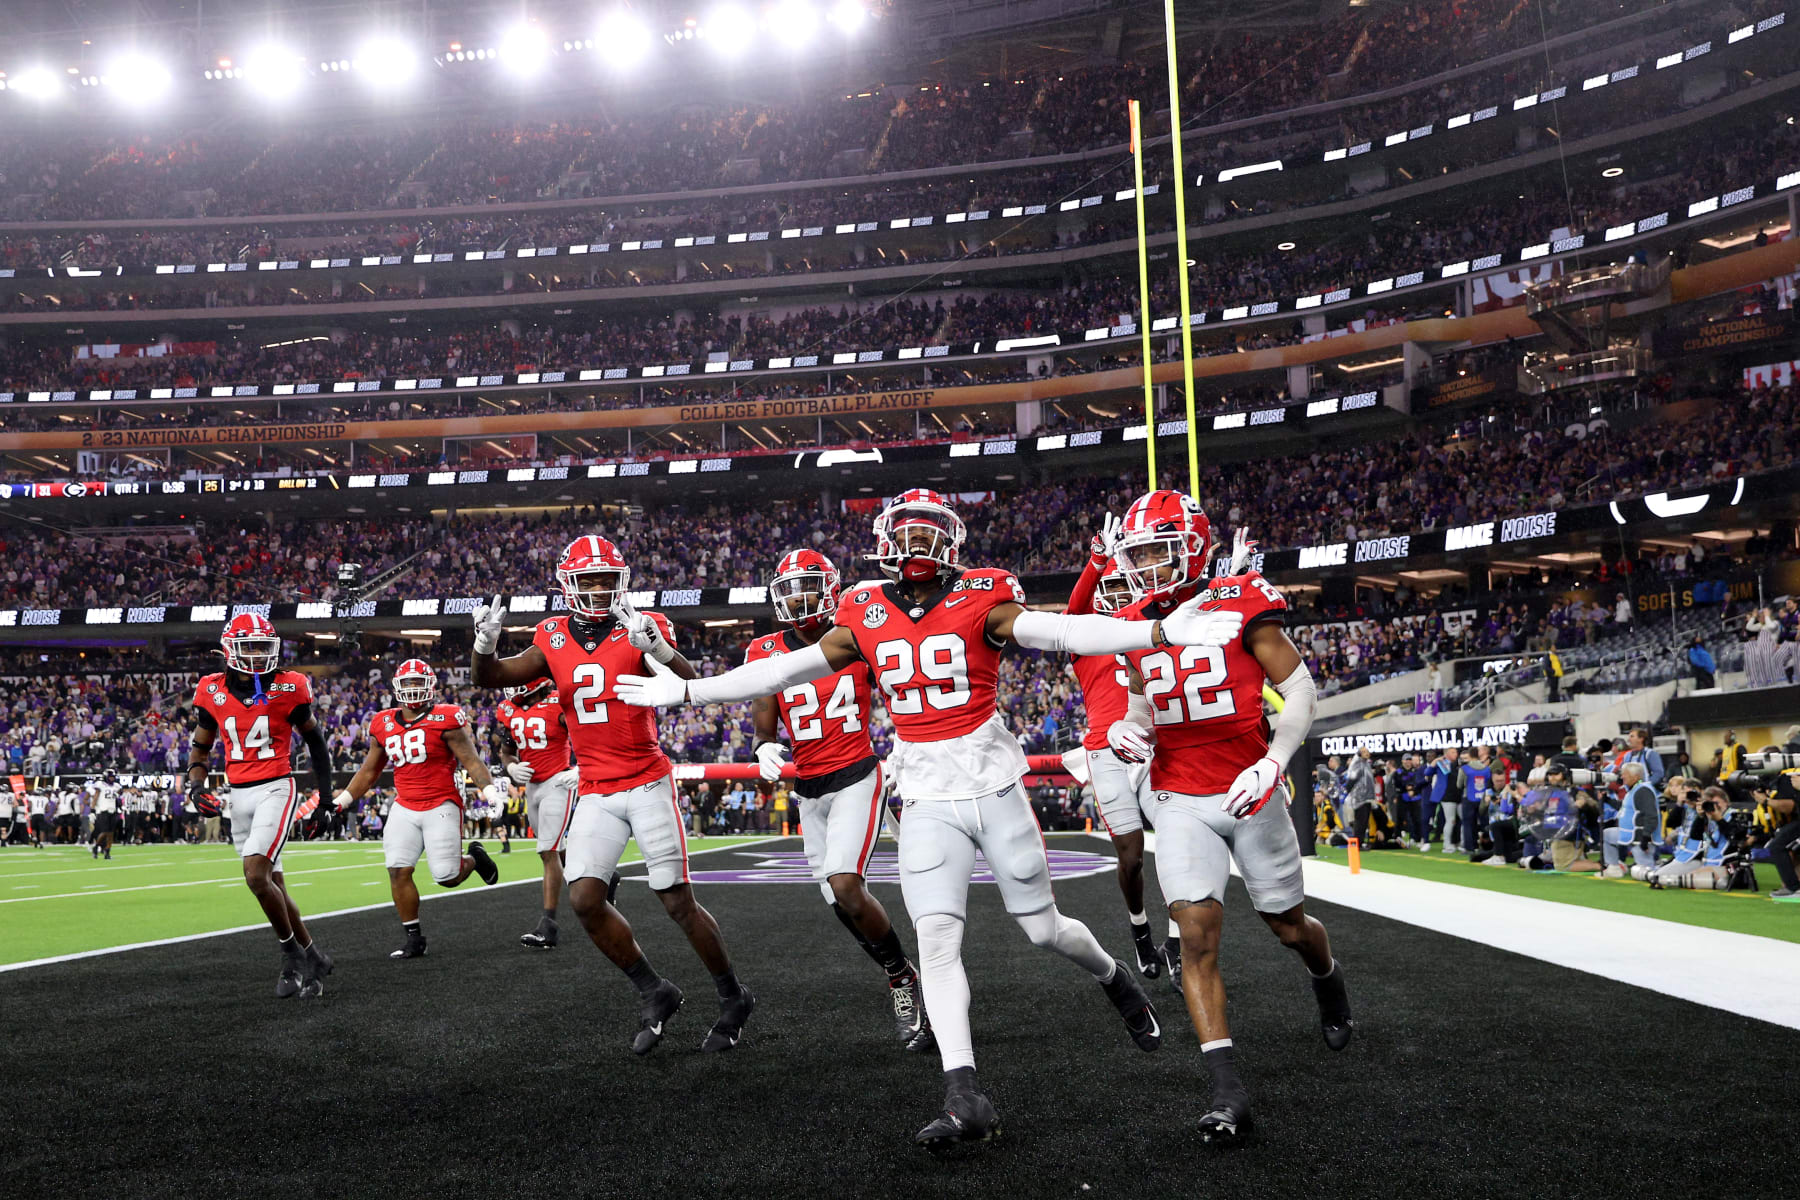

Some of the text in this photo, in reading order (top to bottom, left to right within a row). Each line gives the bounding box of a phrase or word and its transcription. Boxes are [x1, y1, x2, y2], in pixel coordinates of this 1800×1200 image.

[1700, 318, 1766, 337] NATIONAL
[680, 392, 934, 420] COLLEGE FOOTBALL PLAYOFF
[1342, 392, 1377, 410] NOISE
[1250, 408, 1285, 425] NOISE
[127, 428, 212, 445] NATIONAL
[217, 425, 345, 443] CHAMPIONSHIP
[1070, 431, 1102, 446] NOISE
[984, 440, 1016, 455] NOISE
[538, 467, 568, 480] NOISE
[618, 462, 649, 476] NOISE
[701, 459, 731, 472] NOISE
[380, 474, 409, 486] NOISE
[459, 471, 488, 483] NOISE
[23, 485, 31, 497] 7
[38, 484, 52, 497] 31
[114, 482, 140, 495] QTR 2
[162, 481, 186, 494] 0:36
[204, 481, 218, 492] 25
[1445, 512, 1556, 550] MAKE NOISE
[1299, 535, 1410, 568] MAKE NOISE
[661, 589, 701, 606] NOISE
[729, 587, 768, 604] MAKE
[296, 602, 332, 618] MAKE
[402, 599, 439, 615] MAKE
[510, 596, 547, 612] MAKE
[22, 609, 60, 625] NOISE
[86, 607, 166, 623] MAKE NOISE
[191, 606, 229, 622] MAKE
[865, 604, 885, 622] SEC
[875, 632, 972, 716] 29
[1140, 645, 1236, 726] 22
[572, 663, 609, 725] 2
[783, 674, 862, 741] 24
[224, 715, 276, 761] 14
[510, 717, 548, 750] 33
[1321, 723, 1529, 756] COLLEGE FOOTBALL PLAYOFF
[385, 728, 427, 767] 88
